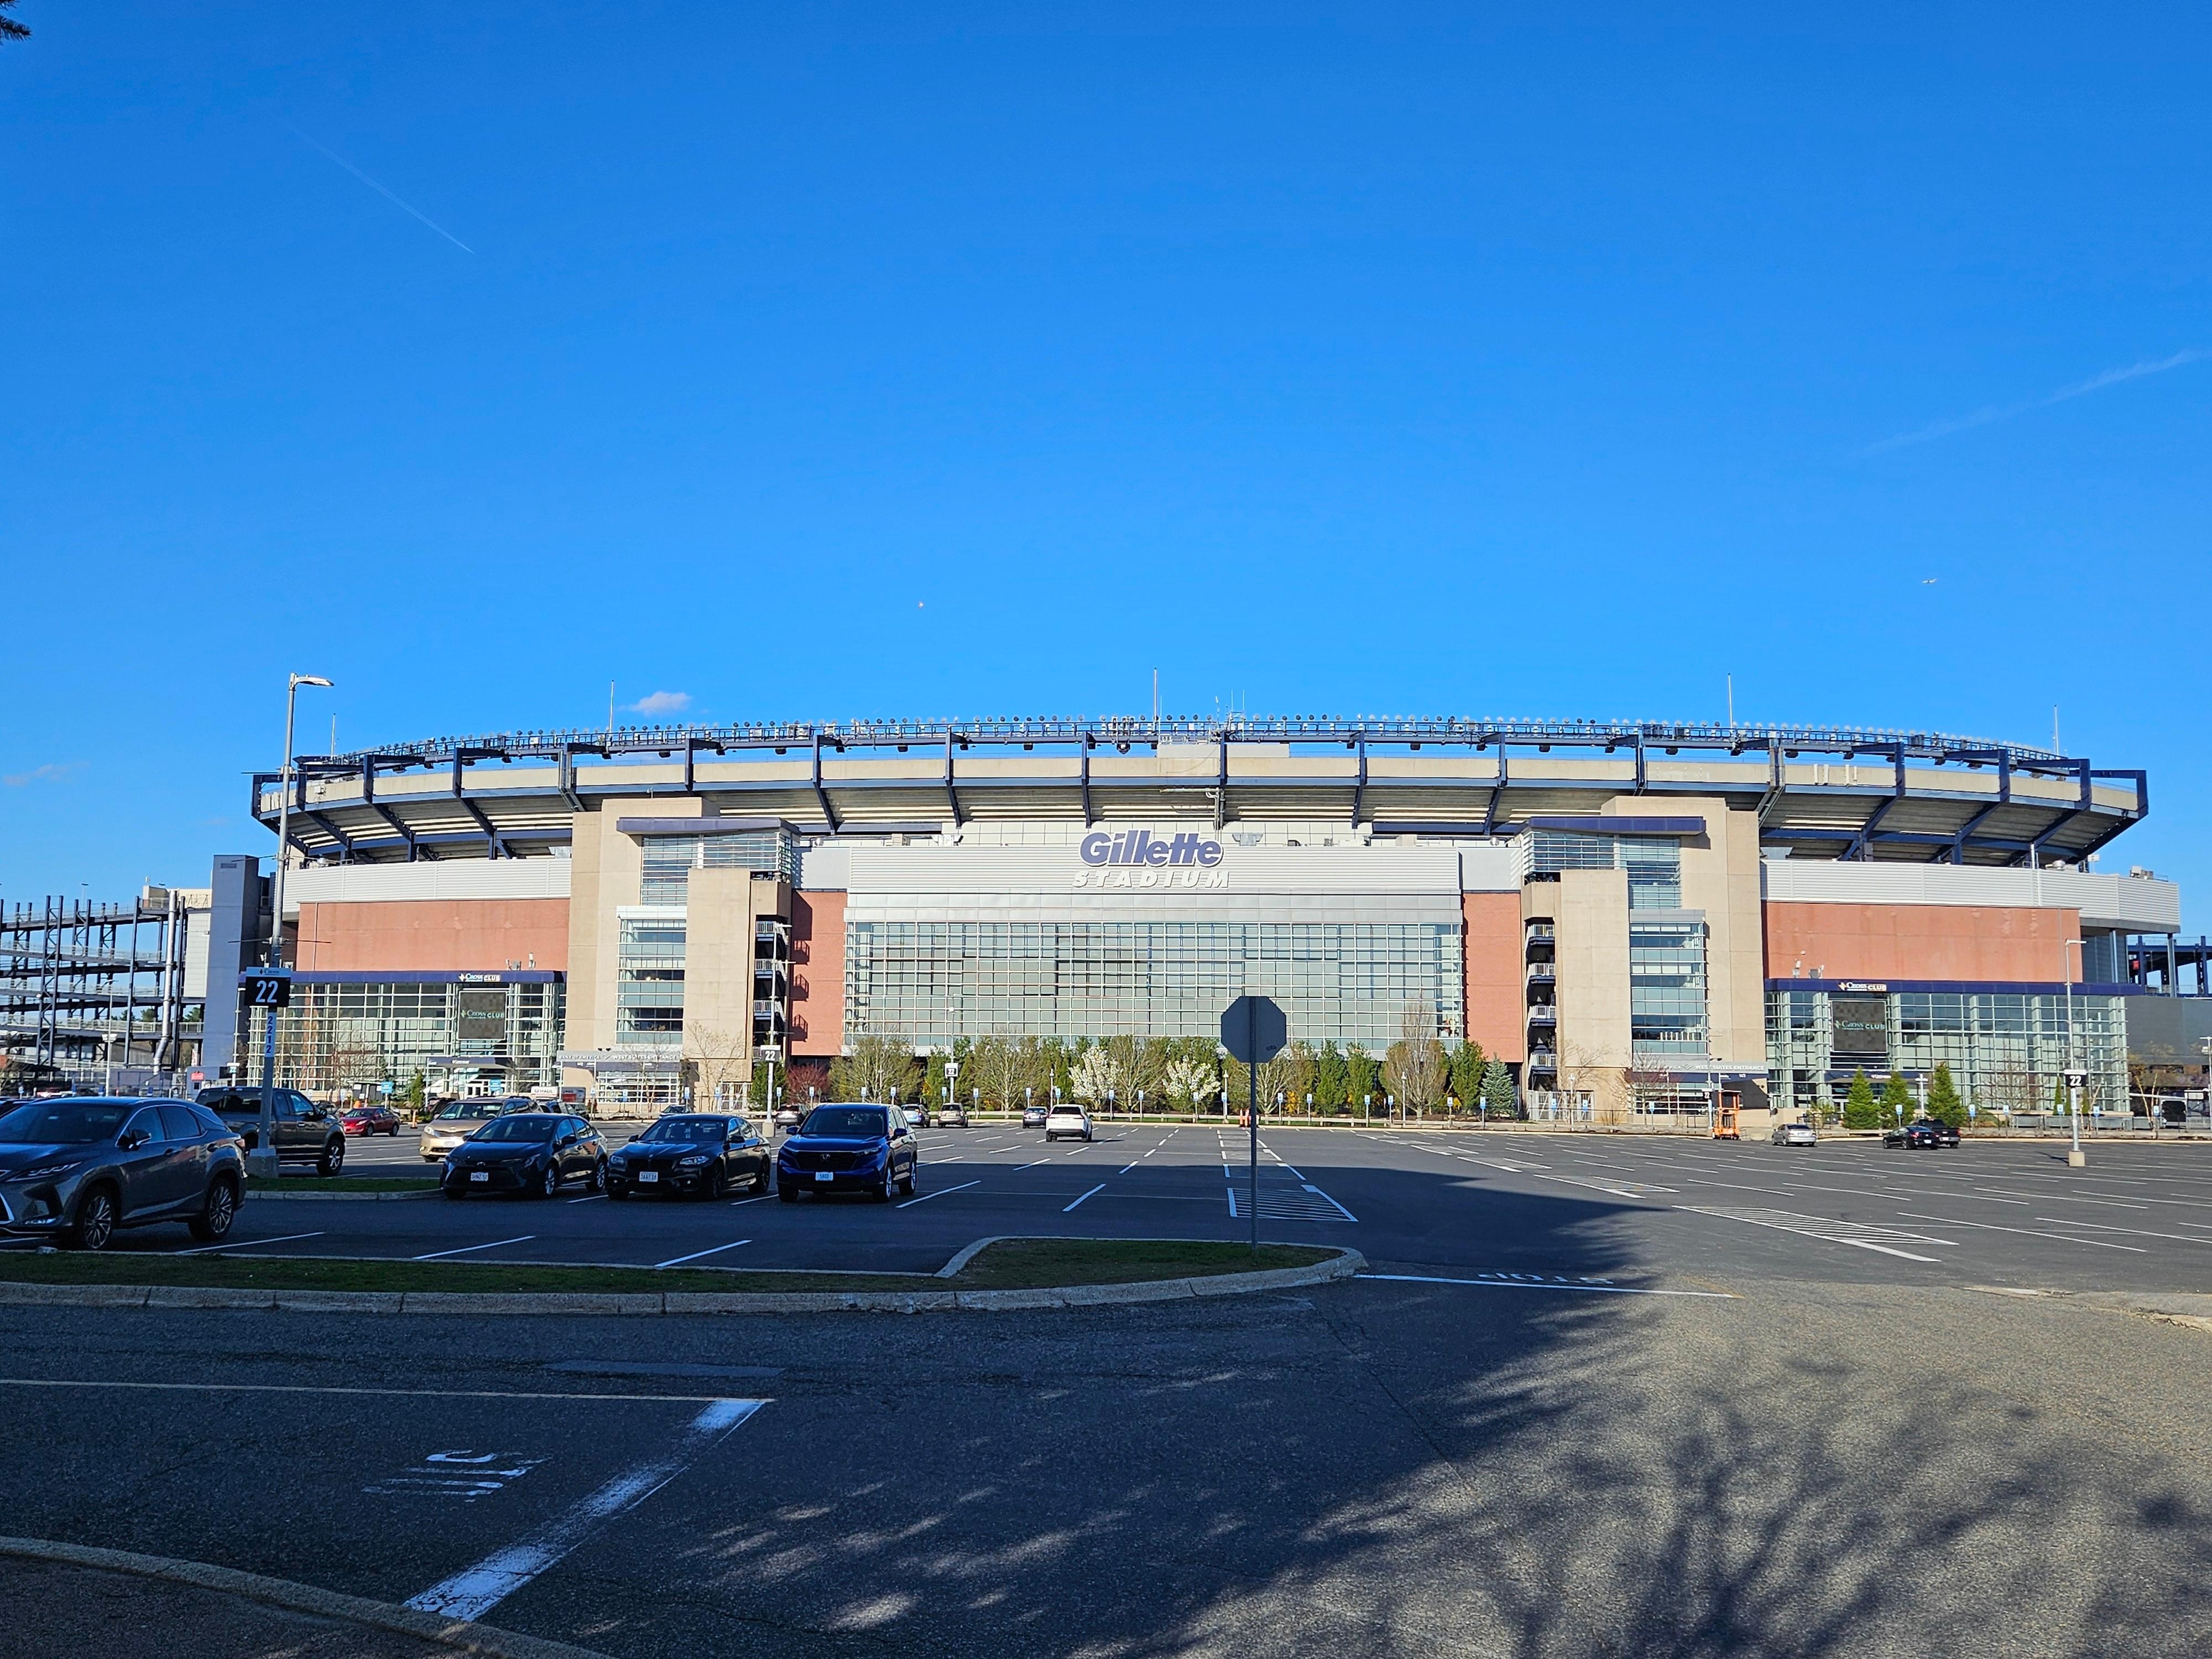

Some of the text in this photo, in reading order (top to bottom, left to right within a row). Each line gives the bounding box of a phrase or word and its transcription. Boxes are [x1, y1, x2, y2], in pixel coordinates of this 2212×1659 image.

[1079, 830, 1222, 865] Gillette
[1072, 871, 1229, 888] STADIUM
[255, 980, 278, 1003] 22
[765, 1051, 775, 1061] 22
[2070, 1076, 2081, 1086] 22
